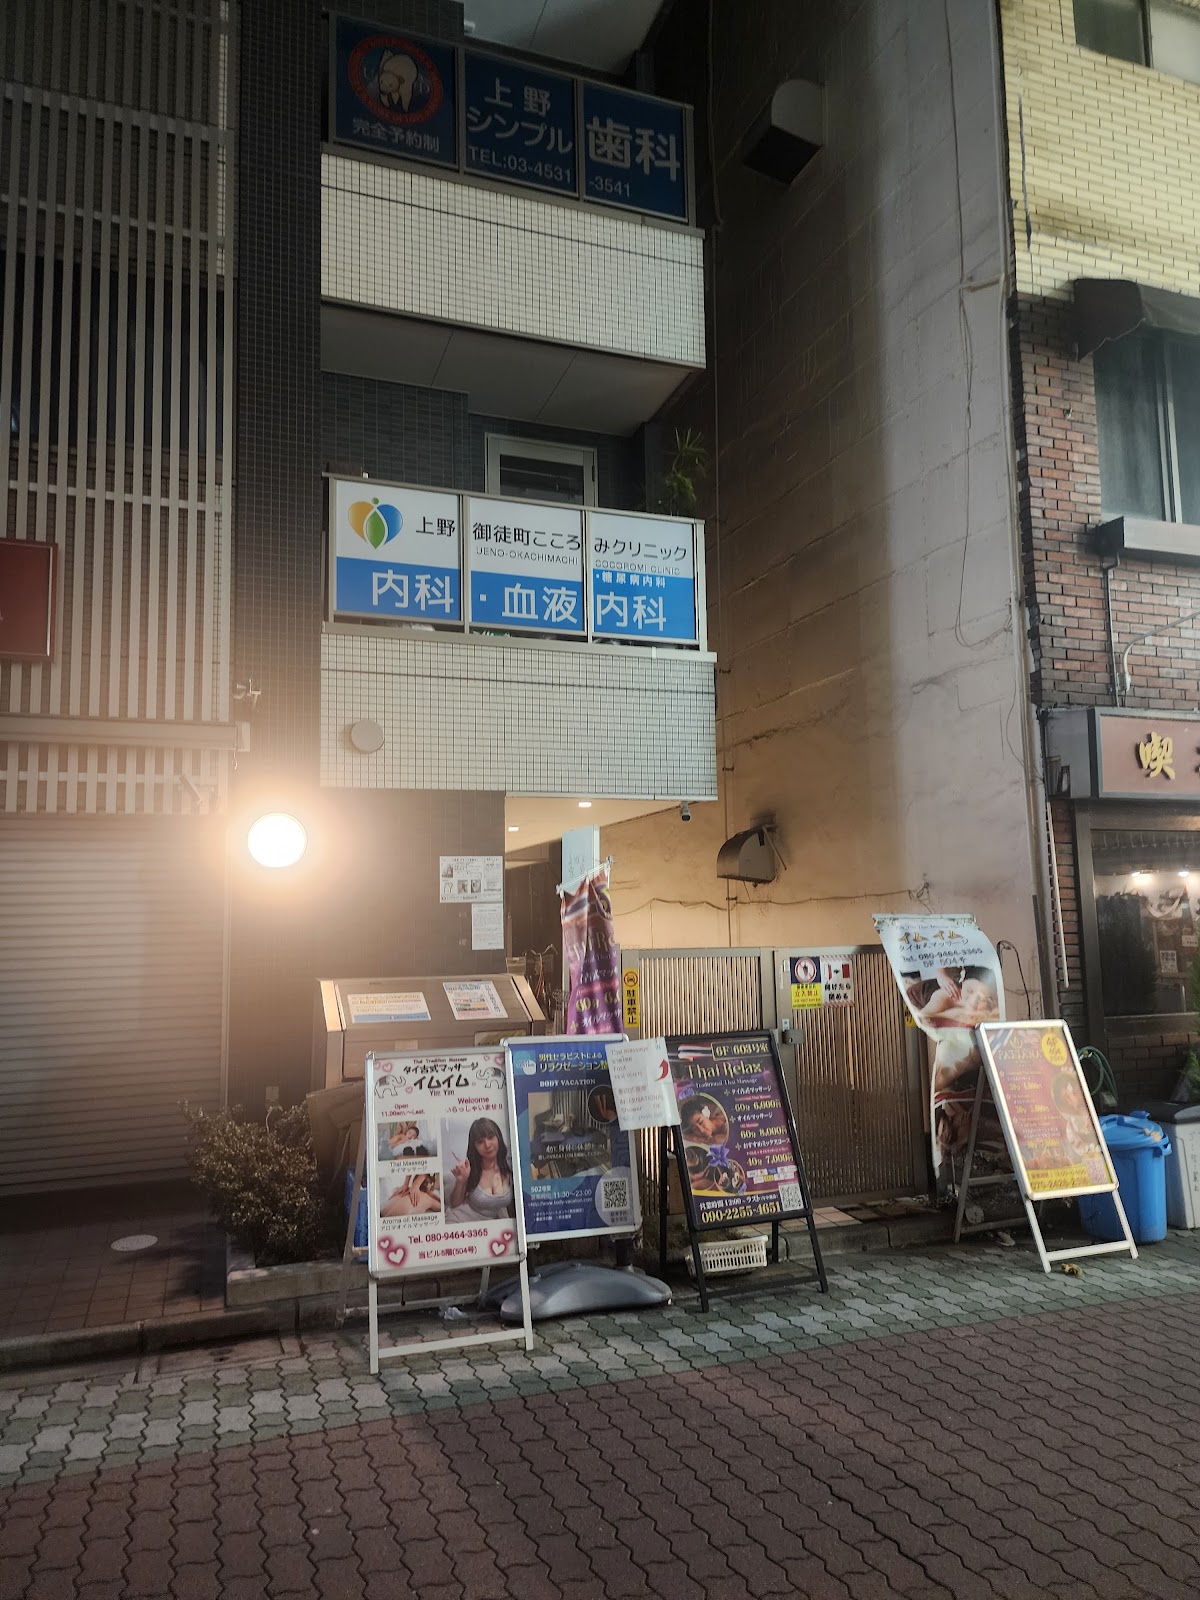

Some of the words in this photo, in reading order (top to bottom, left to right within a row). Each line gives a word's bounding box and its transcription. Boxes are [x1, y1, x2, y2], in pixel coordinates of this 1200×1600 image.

[484, 77, 551, 117] 上野
[353, 117, 440, 153] 完全予約制
[466, 106, 574, 154] シンプル
[587, 116, 681, 182] 歯科
[468, 146, 572, 184] TEL:03-4531
[589, 178, 631, 198] -3541
[416, 516, 456, 537] 上野
[473, 522, 581, 551] 御徒町こころ
[594, 537, 687, 561] みクリニック
[477, 546, 578, 565] UENO-OKACHIMACHI
[595, 559, 648, 573] COCOROMI
[650, 564, 681, 576] CLINIC
[372, 569, 453, 614] 内科
[597, 590, 667, 631] 内科
[825, 983, 851, 991] 開けたら
[626, 989, 637, 1025] 駐車禁止
[539, 1052, 602, 1062] 男性セラピストによる
[723, 1059, 763, 1079] Relax
[414, 1074, 469, 1090] イムイム
[540, 1080, 558, 1088] BODY
[701, 1201, 782, 1224] 090-2255-4651
[408, 1236, 423, 1244] Tel.
[426, 1228, 488, 1243] 080-9464-3365
